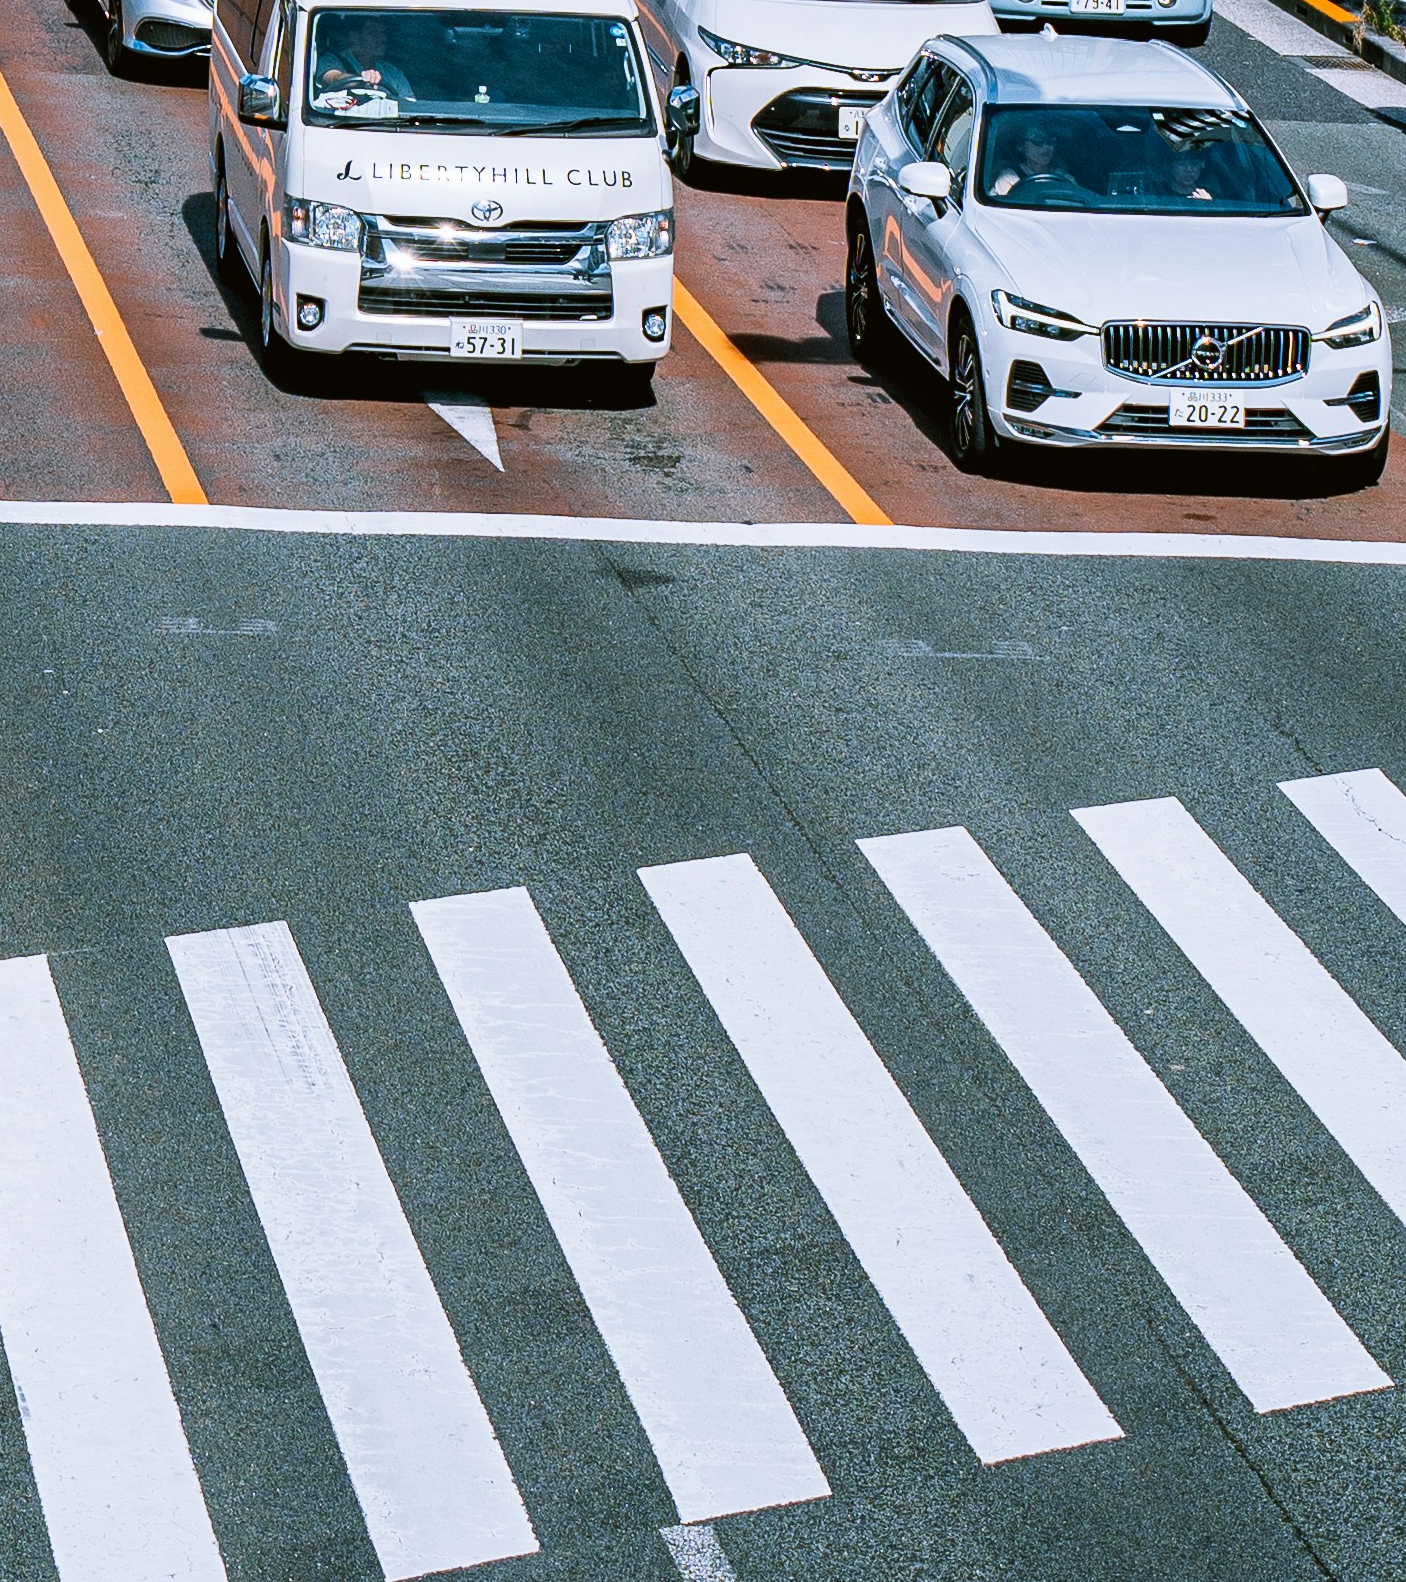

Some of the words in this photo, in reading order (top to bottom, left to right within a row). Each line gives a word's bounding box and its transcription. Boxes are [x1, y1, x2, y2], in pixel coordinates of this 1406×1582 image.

[372, 162, 553, 186] LIBERTYHILL
[567, 168, 633, 188] CLUB
[467, 336, 515, 355] 57-31
[1186, 405, 1240, 424] 20-22
